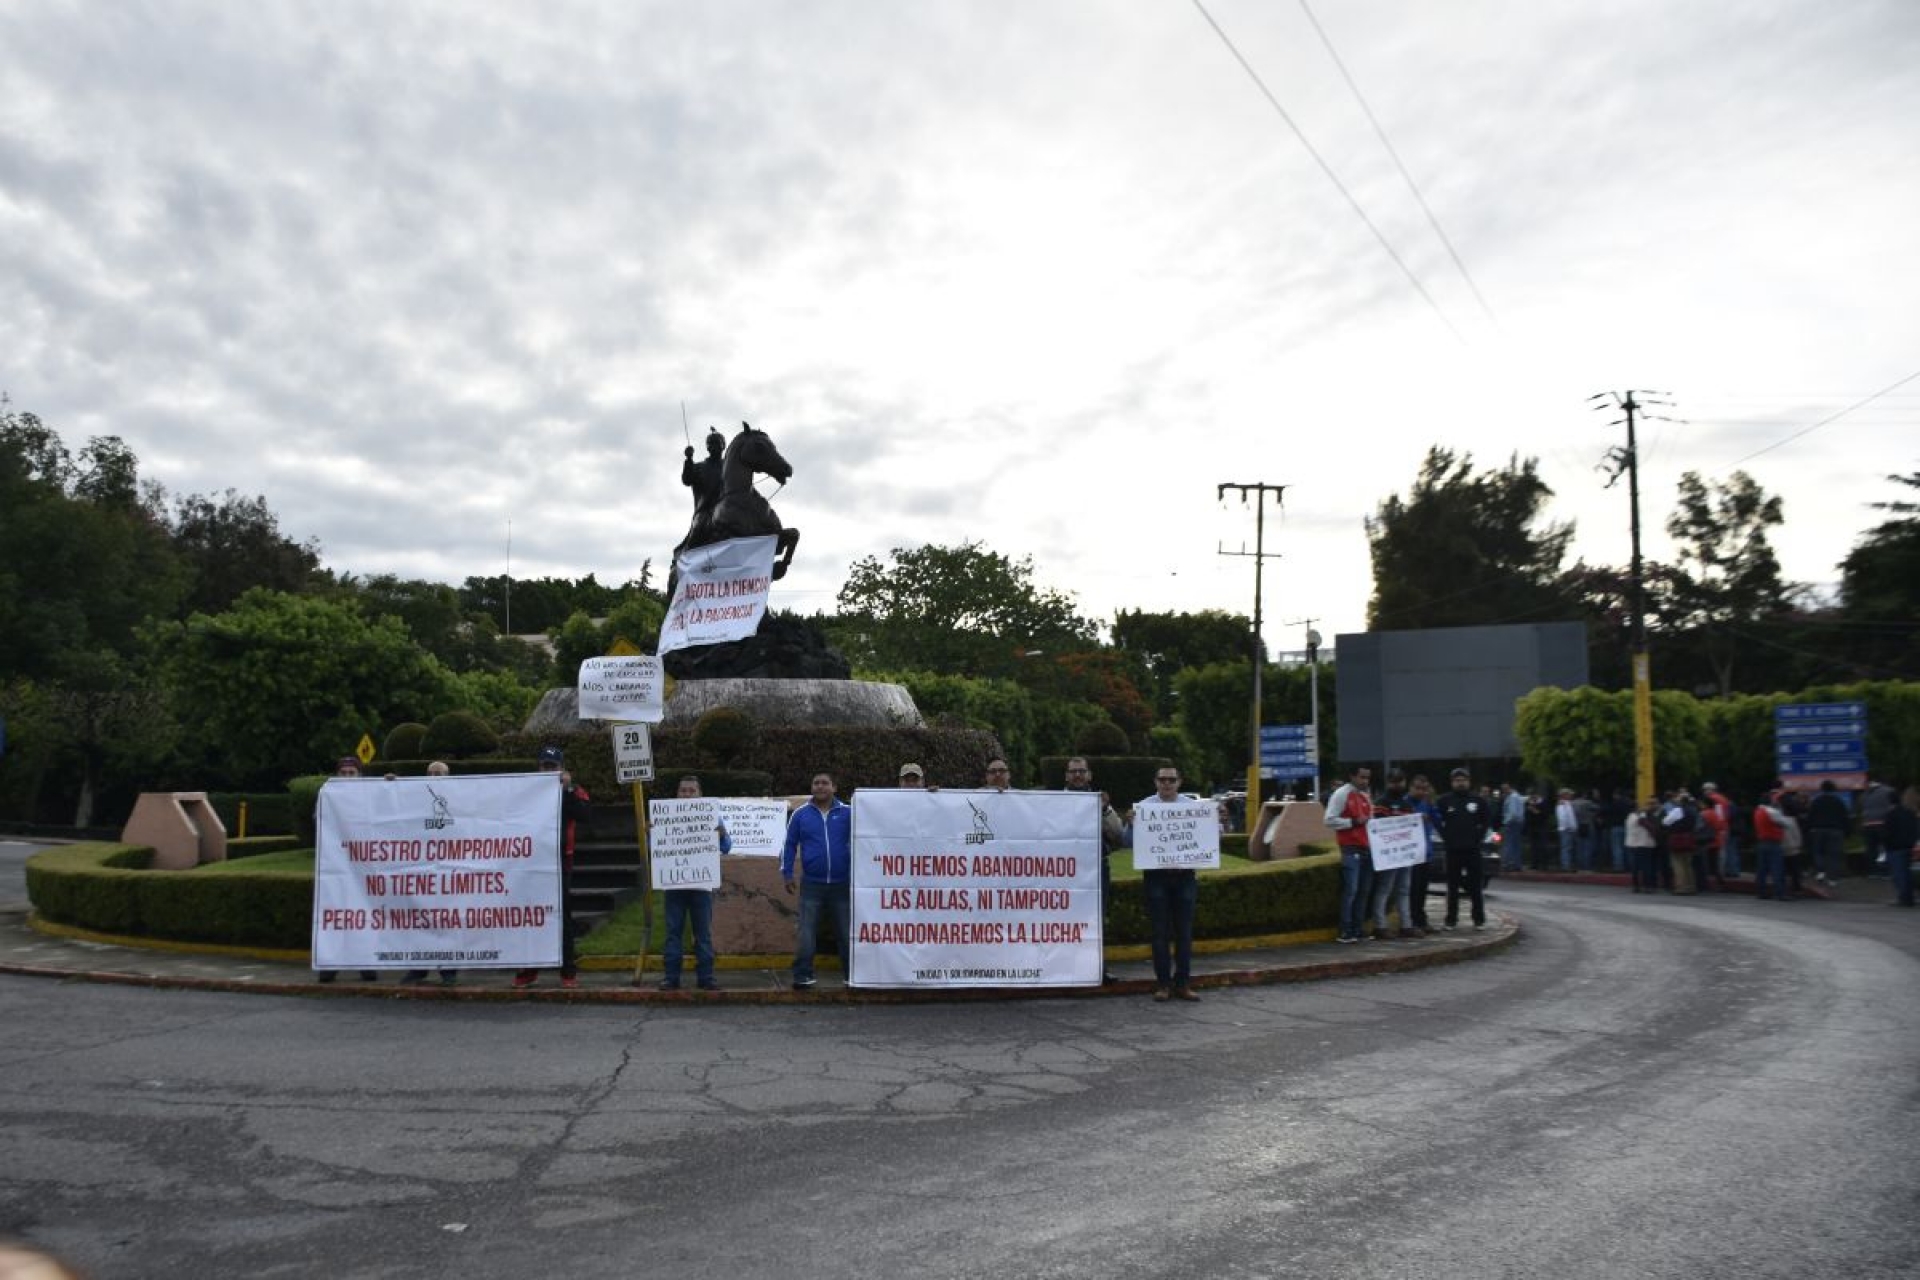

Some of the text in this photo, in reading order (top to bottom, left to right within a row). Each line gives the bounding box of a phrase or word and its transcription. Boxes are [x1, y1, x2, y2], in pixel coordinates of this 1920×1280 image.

[685, 582, 714, 600] AGOTA
[718, 581, 730, 597] LA
[690, 609, 702, 624] LA
[624, 732, 639, 745] 20
[653, 802, 714, 815] NO HEMOS
[665, 826, 684, 836] LAS
[1148, 823, 1162, 832] NO
[1182, 821, 1196, 830] UN
[1158, 832, 1193, 843] GASTO
[426, 836, 532, 861] COMPROMISO
[675, 858, 689, 867] LA
[909, 856, 968, 877] HEMOS
[972, 856, 1076, 878] ABANDONADO
[366, 869, 509, 896] NO TIENE LÍMITES,
[660, 866, 712, 884] LUCHA
[880, 889, 1070, 913] LAS AULAS, NI TAMPOCO
[323, 909, 366, 931] PERO
[371, 905, 386, 930] SÍ
[390, 908, 462, 930] NUESTRA
[859, 923, 1004, 944] ABANDONAREMOS
[1007, 923, 1027, 943] LA
[455, 951, 464, 960] EN
[467, 950, 475, 960] LA
[997, 969, 1006, 979] EN
[1008, 968, 1017, 978] LA
